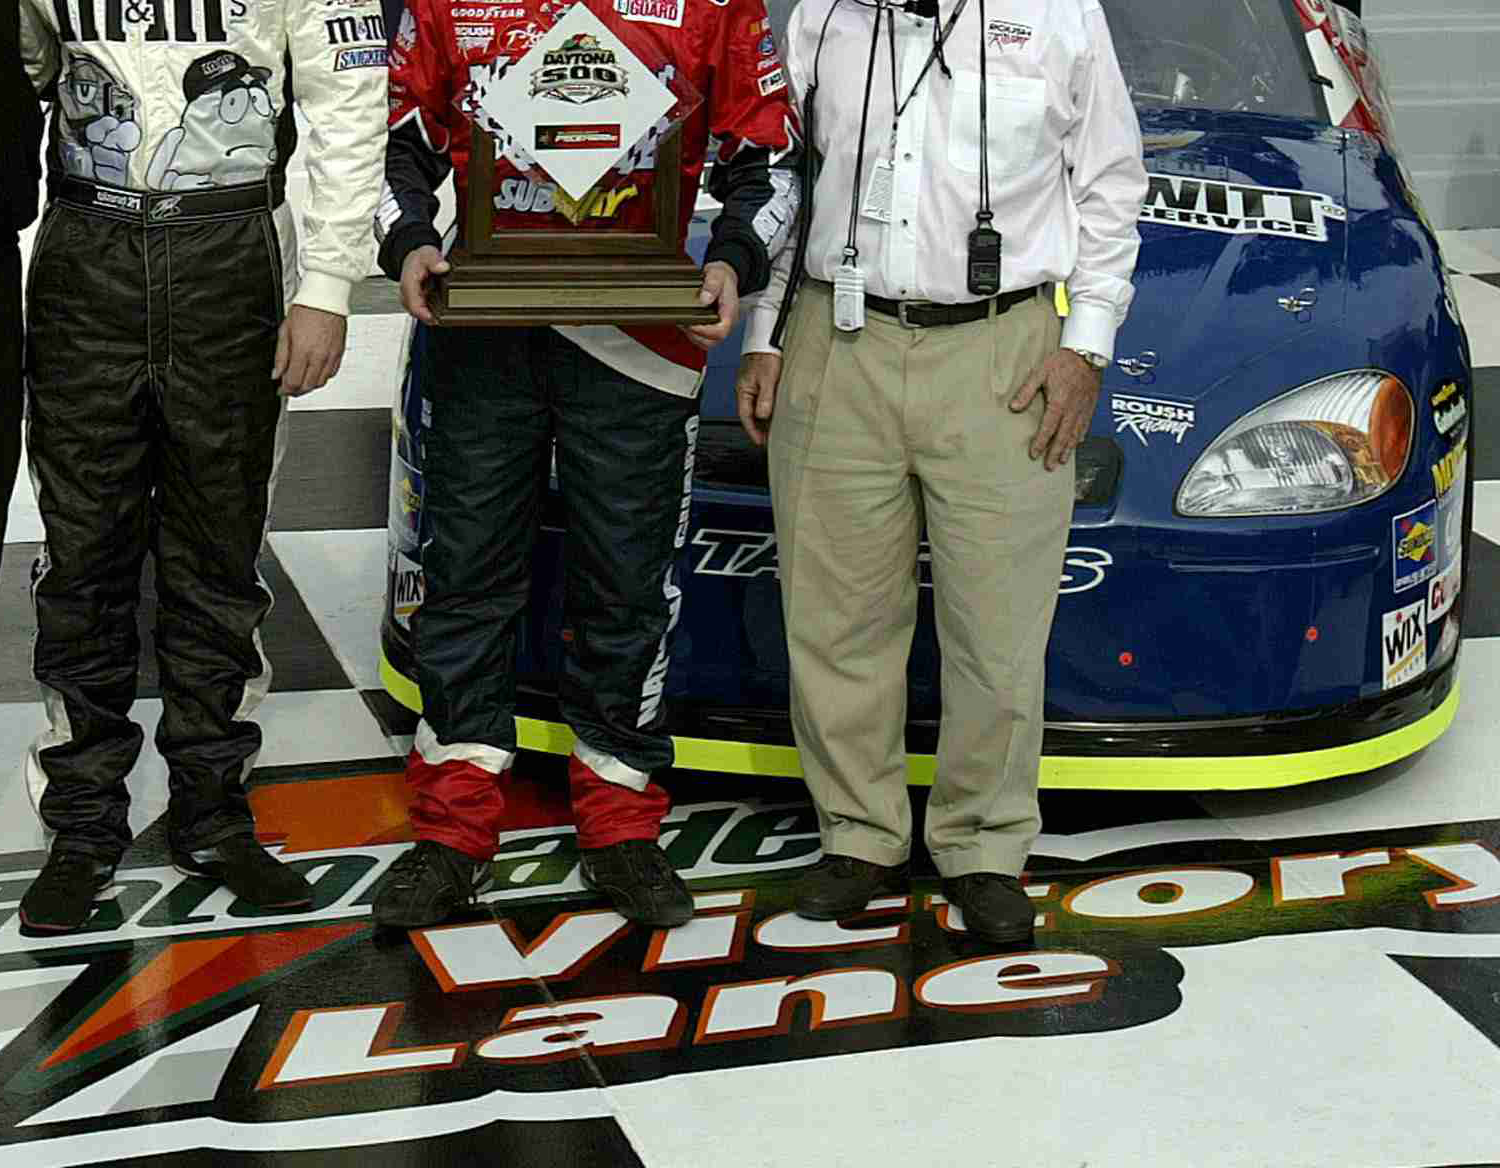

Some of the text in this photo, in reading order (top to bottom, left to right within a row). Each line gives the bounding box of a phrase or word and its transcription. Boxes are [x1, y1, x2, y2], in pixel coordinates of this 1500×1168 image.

[451, 7, 525, 21] GOODYEAR
[629, 0, 678, 21] GUARD
[541, 65, 618, 83] 500
[542, 52, 616, 65] DAYTONA
[493, 178, 639, 216] SUBAY
[1111, 398, 1195, 422] ROUSH
[1112, 411, 1195, 447] Racing
[692, 529, 1113, 594] TAS
[1385, 605, 1424, 665] WIX
[410, 841, 1500, 994] Vicory
[254, 949, 1119, 1093] Lane
